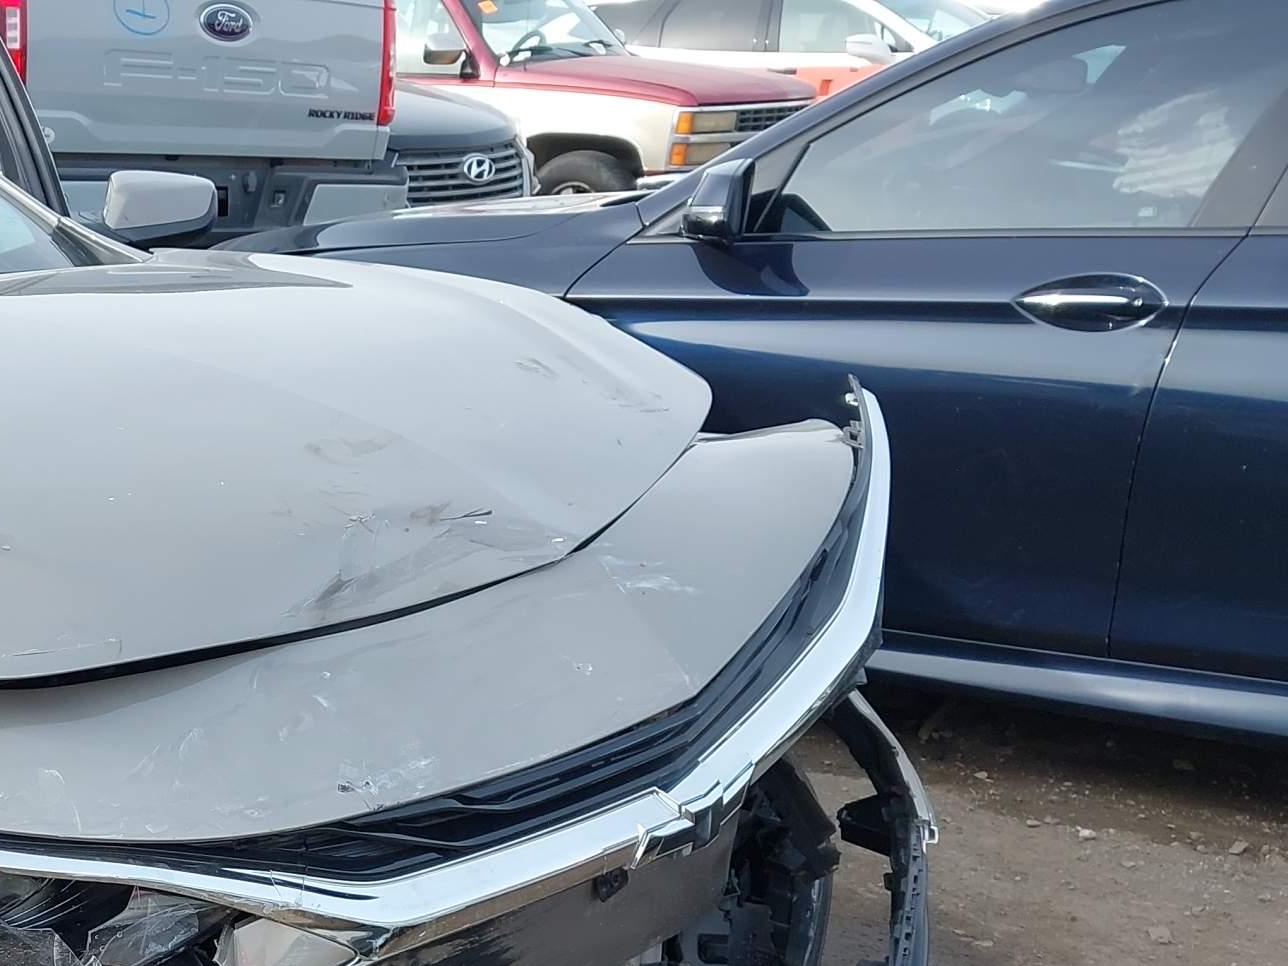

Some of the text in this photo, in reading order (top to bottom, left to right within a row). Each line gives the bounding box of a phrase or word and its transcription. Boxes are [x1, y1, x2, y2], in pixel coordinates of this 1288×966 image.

[214, 10, 243, 33] Ford
[307, 108, 376, 121] ROCKY RIDGE
